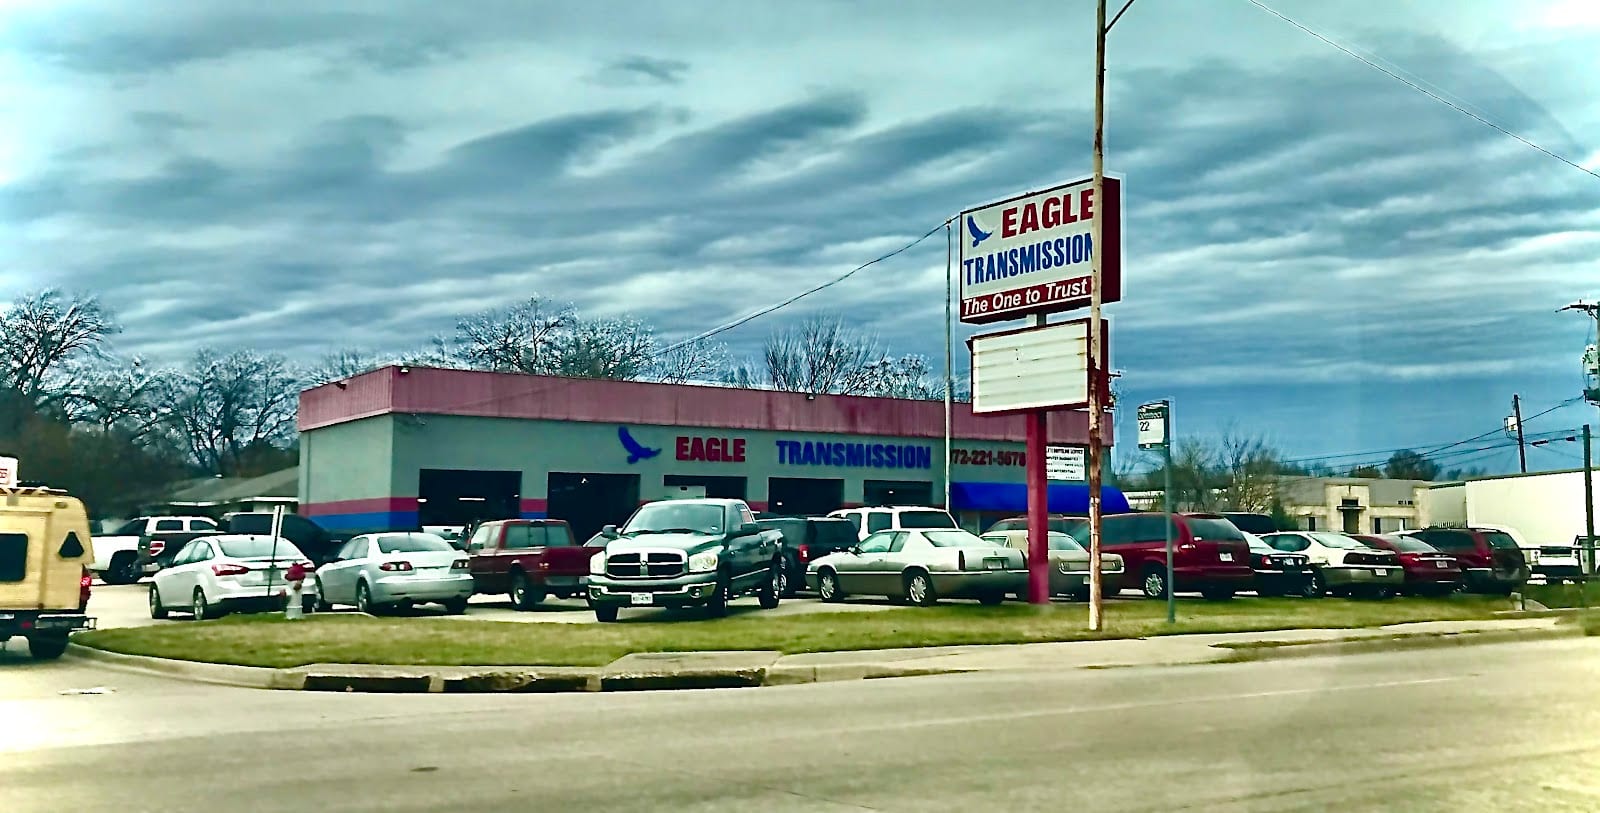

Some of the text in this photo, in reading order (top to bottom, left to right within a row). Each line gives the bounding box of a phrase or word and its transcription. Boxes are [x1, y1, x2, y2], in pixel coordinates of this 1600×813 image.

[1002, 188, 1094, 239] EAGLE
[963, 232, 1093, 286] TRANSMISSION
[963, 278, 1088, 315] The One to Trust
[1139, 421, 1150, 431] 22
[675, 436, 931, 469] EAGLE TRANSMISSION
